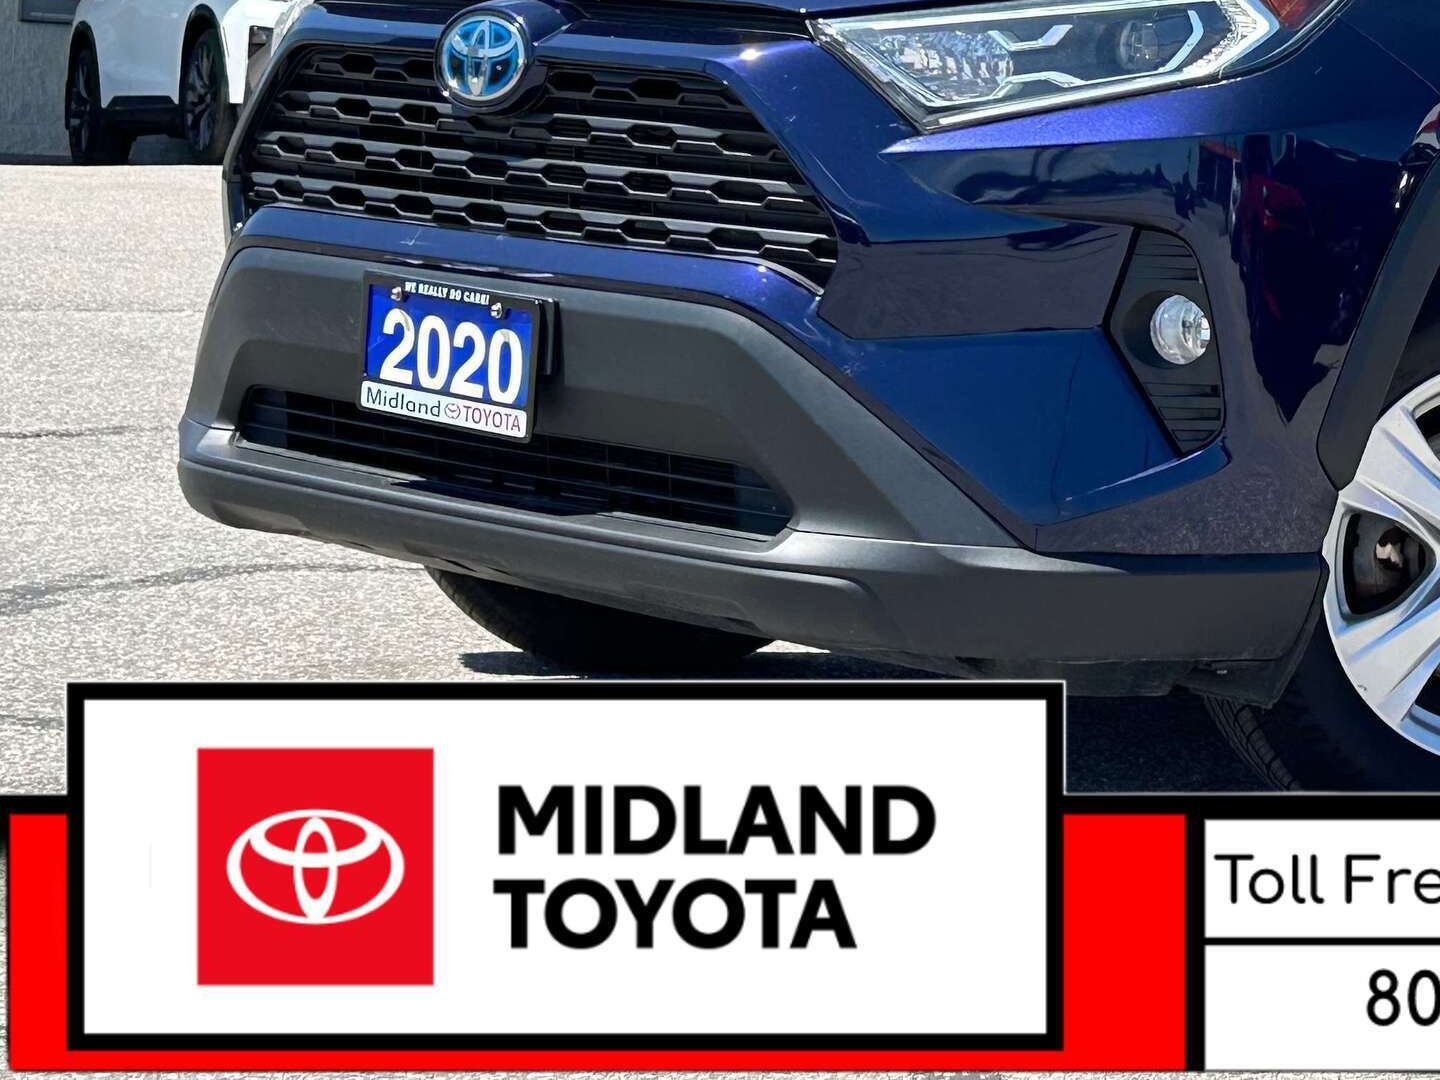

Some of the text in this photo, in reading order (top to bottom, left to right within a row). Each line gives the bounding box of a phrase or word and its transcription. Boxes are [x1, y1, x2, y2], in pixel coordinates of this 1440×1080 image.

[418, 283, 448, 299] REALLY
[379, 308, 523, 404] 2020
[366, 386, 521, 432] Midland TOYOTA
